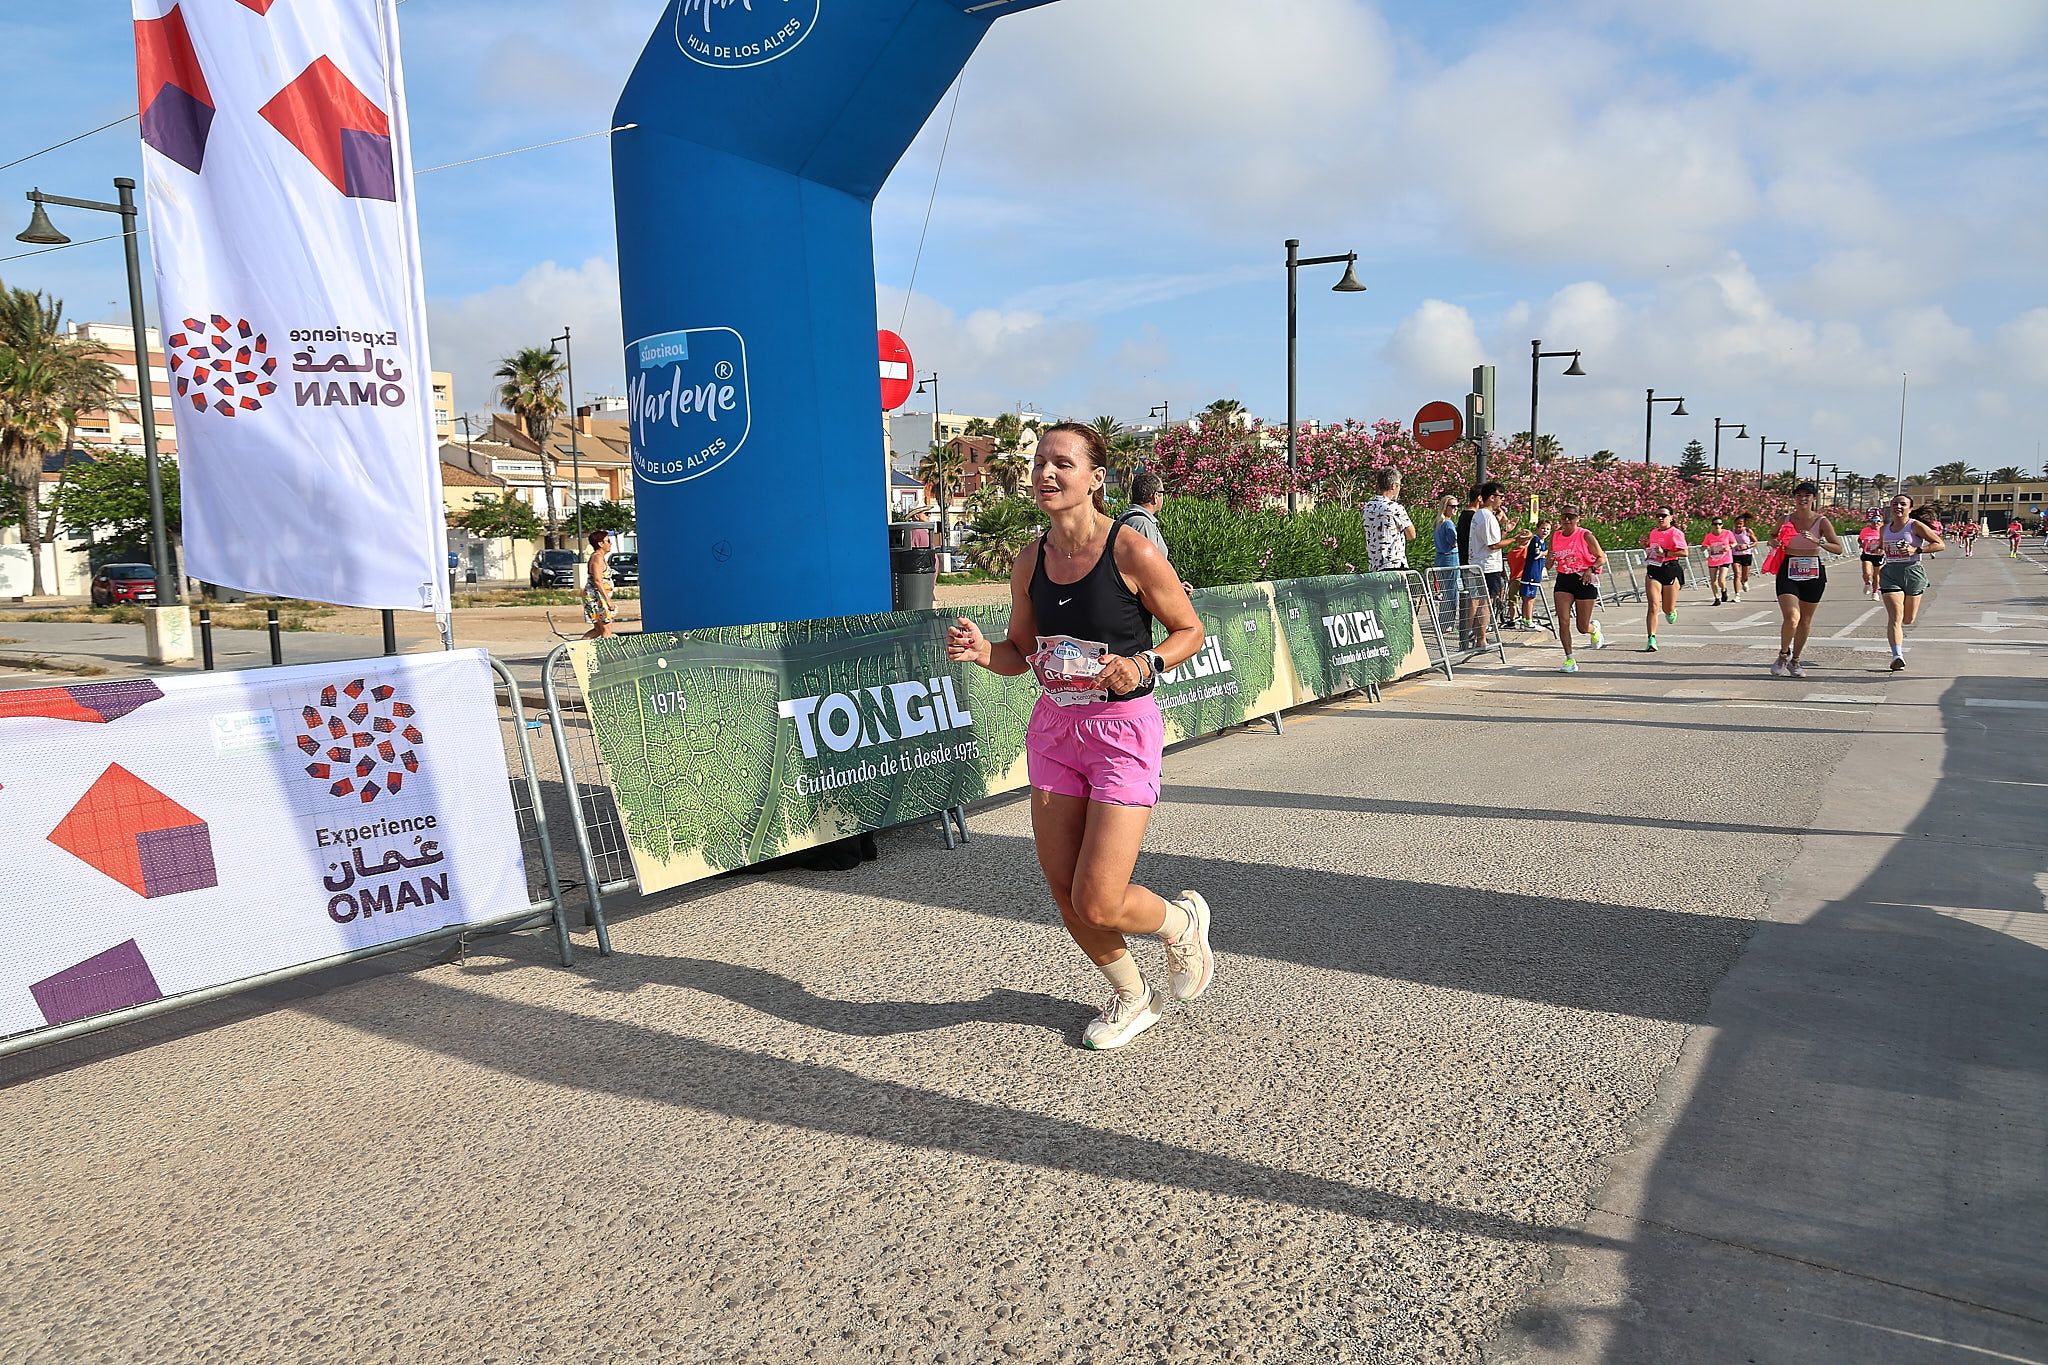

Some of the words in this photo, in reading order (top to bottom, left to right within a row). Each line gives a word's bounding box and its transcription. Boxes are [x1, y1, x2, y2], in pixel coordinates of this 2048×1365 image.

[687, 34, 710, 55] HIJA
[714, 46, 731, 58] DE
[735, 43, 760, 58] LOS
[764, 18, 801, 51] ALPES
[647, 461, 659, 474] DE
[661, 460, 683, 474] LOS
[687, 437, 726, 469] ALPES
[650, 690, 687, 714] 1975
[1188, 687, 1198, 702] de
[1197, 685, 1203, 700] ti
[1203, 681, 1223, 699] desde
[1223, 680, 1239, 696] 1975
[795, 760, 876, 796] Cuidando
[879, 755, 899, 777] de
[899, 750, 912, 772] ti
[914, 746, 951, 767] desde
[954, 740, 980, 762] 1975
[315, 814, 437, 848] Experience
[327, 872, 450, 924] OMAN
